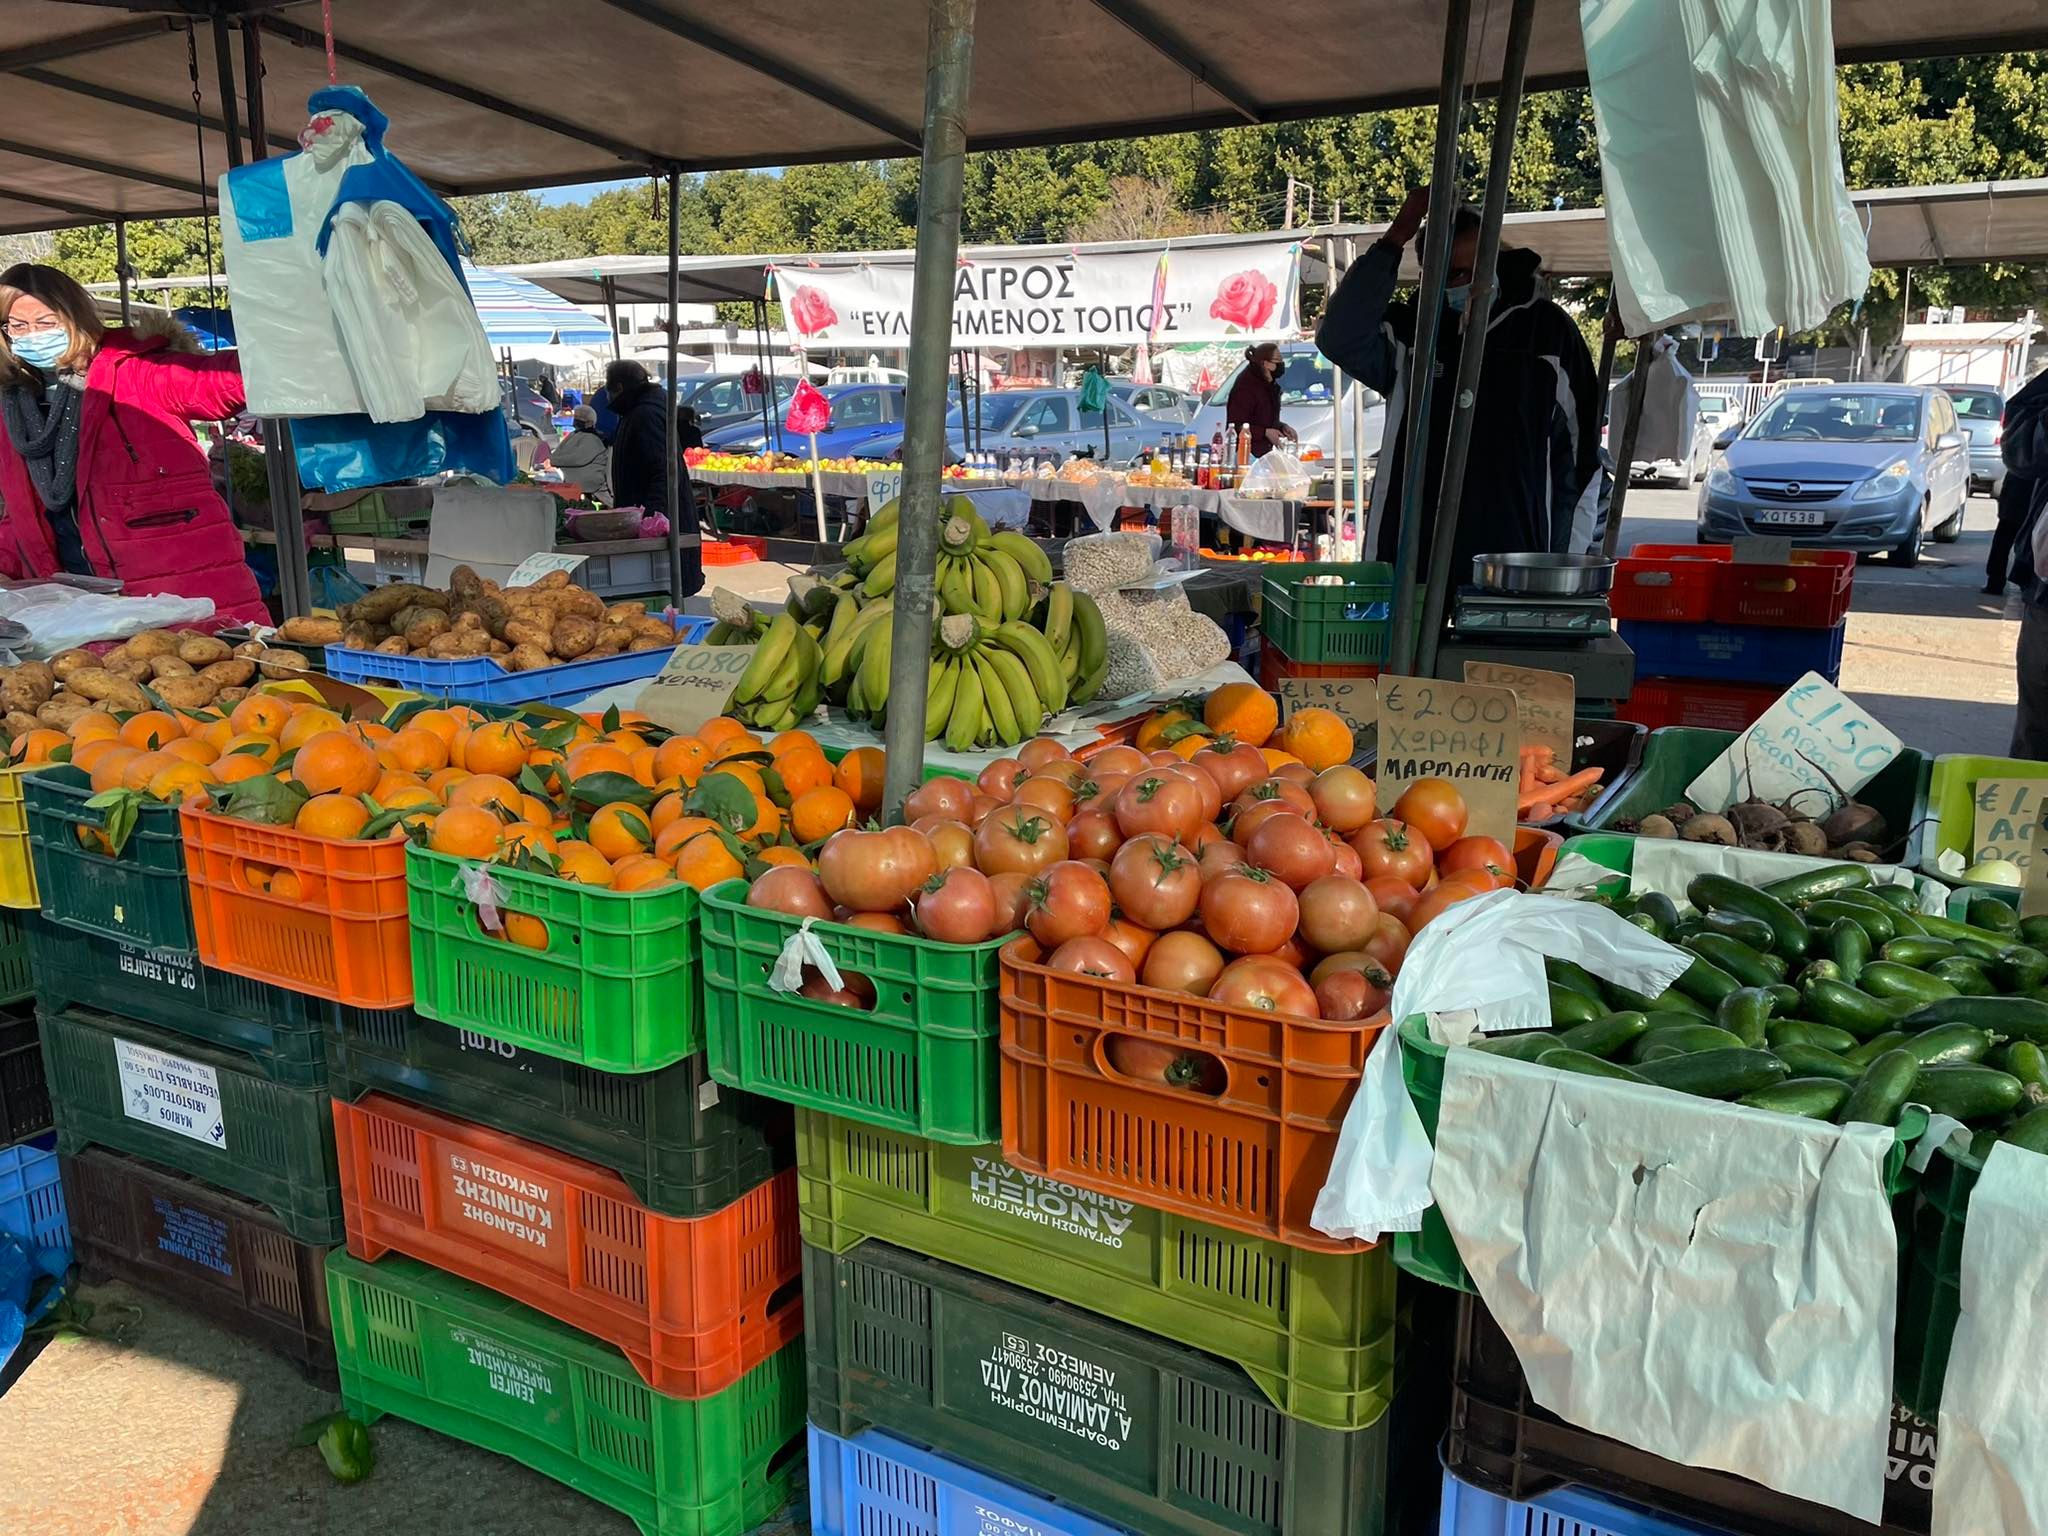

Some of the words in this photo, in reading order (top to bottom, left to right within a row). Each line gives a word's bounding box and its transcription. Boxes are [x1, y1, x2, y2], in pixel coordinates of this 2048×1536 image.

[955, 265, 1074, 300] ΑΓΡΟΣ
[850, 308, 1065, 335] “ΕΥΛΗΜΕΝΟΣ
[1384, 758, 1514, 782] ΜΑΡΜΑΝΤΑ
[120, 954, 163, 981] ΣΕΔΙΓΕΠ
[147, 1067, 164, 1081] LTD
[166, 1072, 219, 1100] VEGETABLES
[143, 1083, 206, 1114] ARISTOTELOUS
[160, 1107, 193, 1129] MARIOS
[470, 1161, 548, 1203] ΛΕΥΚΩΣΙΑ
[971, 1156, 1015, 1179] ΛΤΔ
[452, 1174, 553, 1230] ΚΑΠΝΙΣΗΣ
[970, 1170, 1133, 1236] ΑΝΟΙΞΗ
[971, 1192, 1049, 1225] ΠΑΡΑΓΩΓΩΝ
[462, 1202, 547, 1248] ΚΛΕΑΝΘΗΣ
[1051, 1216, 1123, 1249] ΟΡΓΑΝΩΣΗ
[991, 1345, 1039, 1376] 25390417
[1007, 1336, 1026, 1353] €5
[467, 1347, 552, 1395] ΠΑΡΕΚΚΛΗΣΙΑΣ
[980, 1359, 1011, 1393] ΛΤΔ
[1035, 1343, 1115, 1387] ΛΕΜΕΣΟΣ
[489, 1371, 535, 1405] ΣΕΔΙΓΕΠ
[1048, 1367, 1098, 1398] 25390490
[1018, 1373, 1110, 1432] ΔΑΜΙΑΝΟΣ
[1100, 1387, 1127, 1411] ΤΗΛ.
[991, 1391, 1121, 1451] ΦΘΑΡΤΕΜΠΟΡΙΚΗ
[1114, 1411, 1132, 1442] Α.
